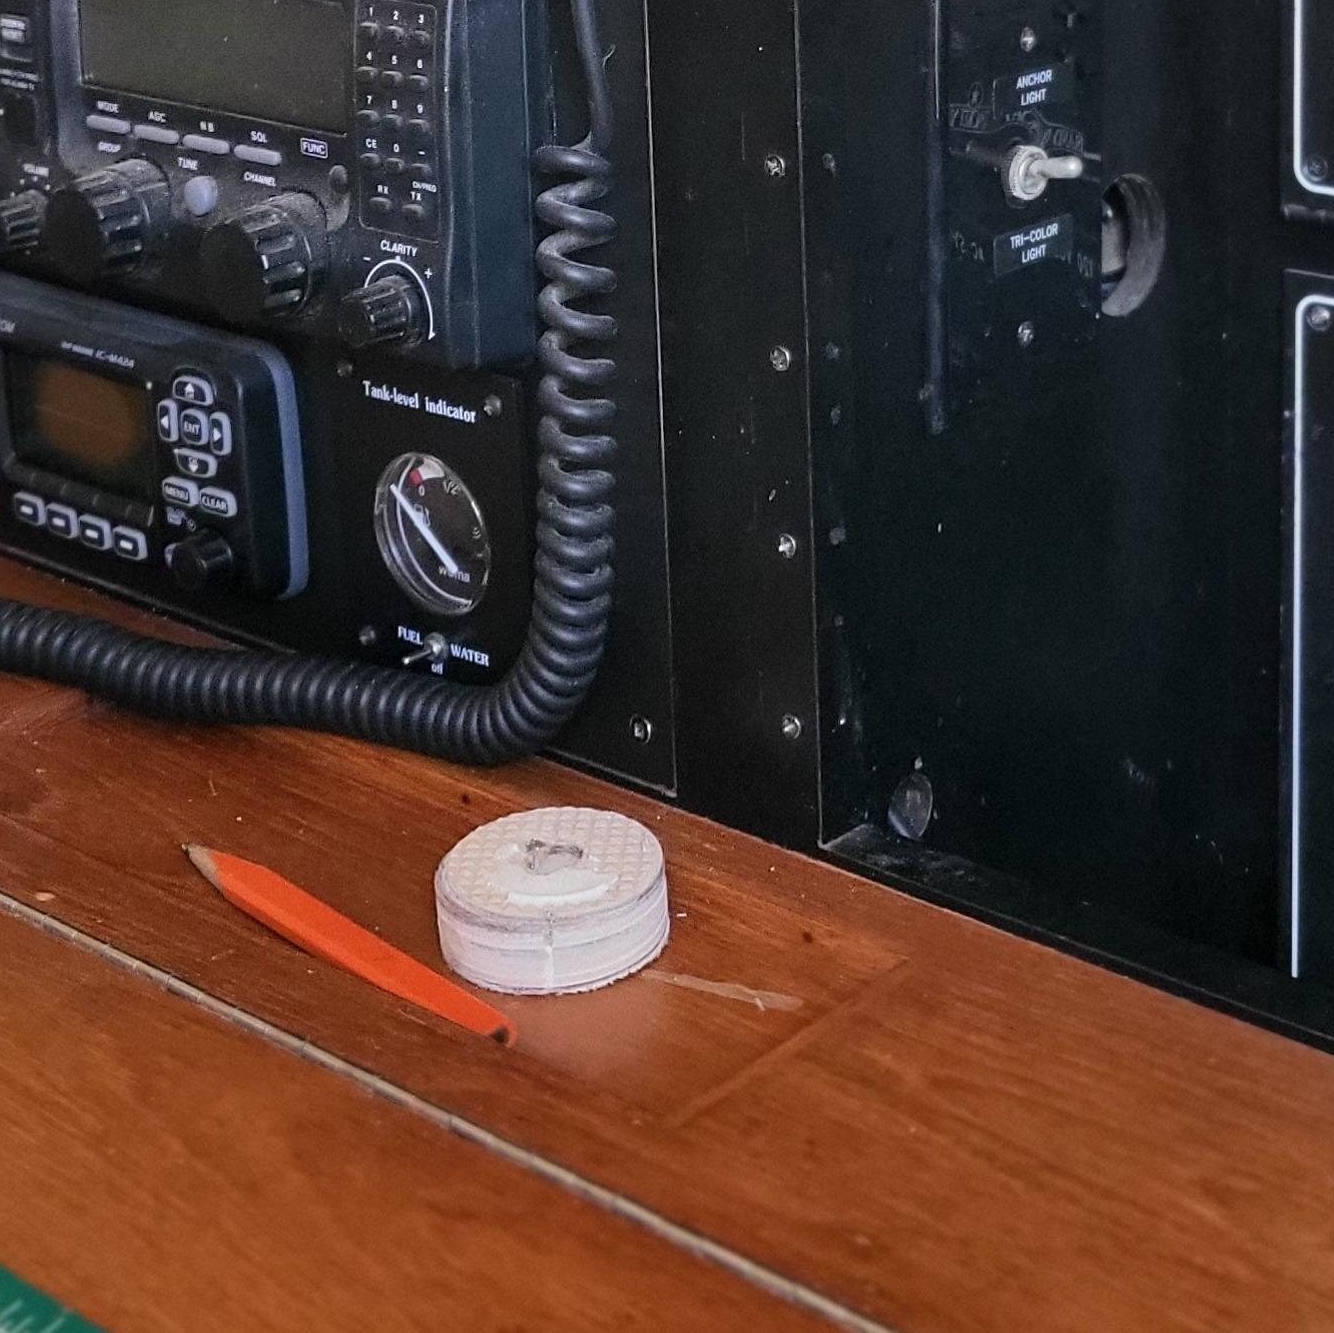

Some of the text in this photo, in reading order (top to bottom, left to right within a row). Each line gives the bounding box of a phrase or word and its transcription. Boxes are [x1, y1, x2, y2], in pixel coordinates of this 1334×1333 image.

[1016, 70, 1052, 89] ANCHOR
[1021, 89, 1046, 105] LIGHT
[97, 101, 119, 113] MODE
[251, 131, 267, 143] SQL
[366, 138, 377, 148] CE
[303, 142, 325, 155] FUNC
[178, 158, 198, 170] TUNE
[243, 172, 277, 187] CHANNEL
[1010, 224, 1058, 249] TRI-COLOR
[381, 240, 417, 256] CLARITY
[1022, 245, 1046, 263] LIGHT
[363, 381, 476, 423] Tank-level indicator
[202, 496, 227, 511] CLEAR
[398, 626, 423, 645] FUEL
[450, 643, 489, 666] WATER
